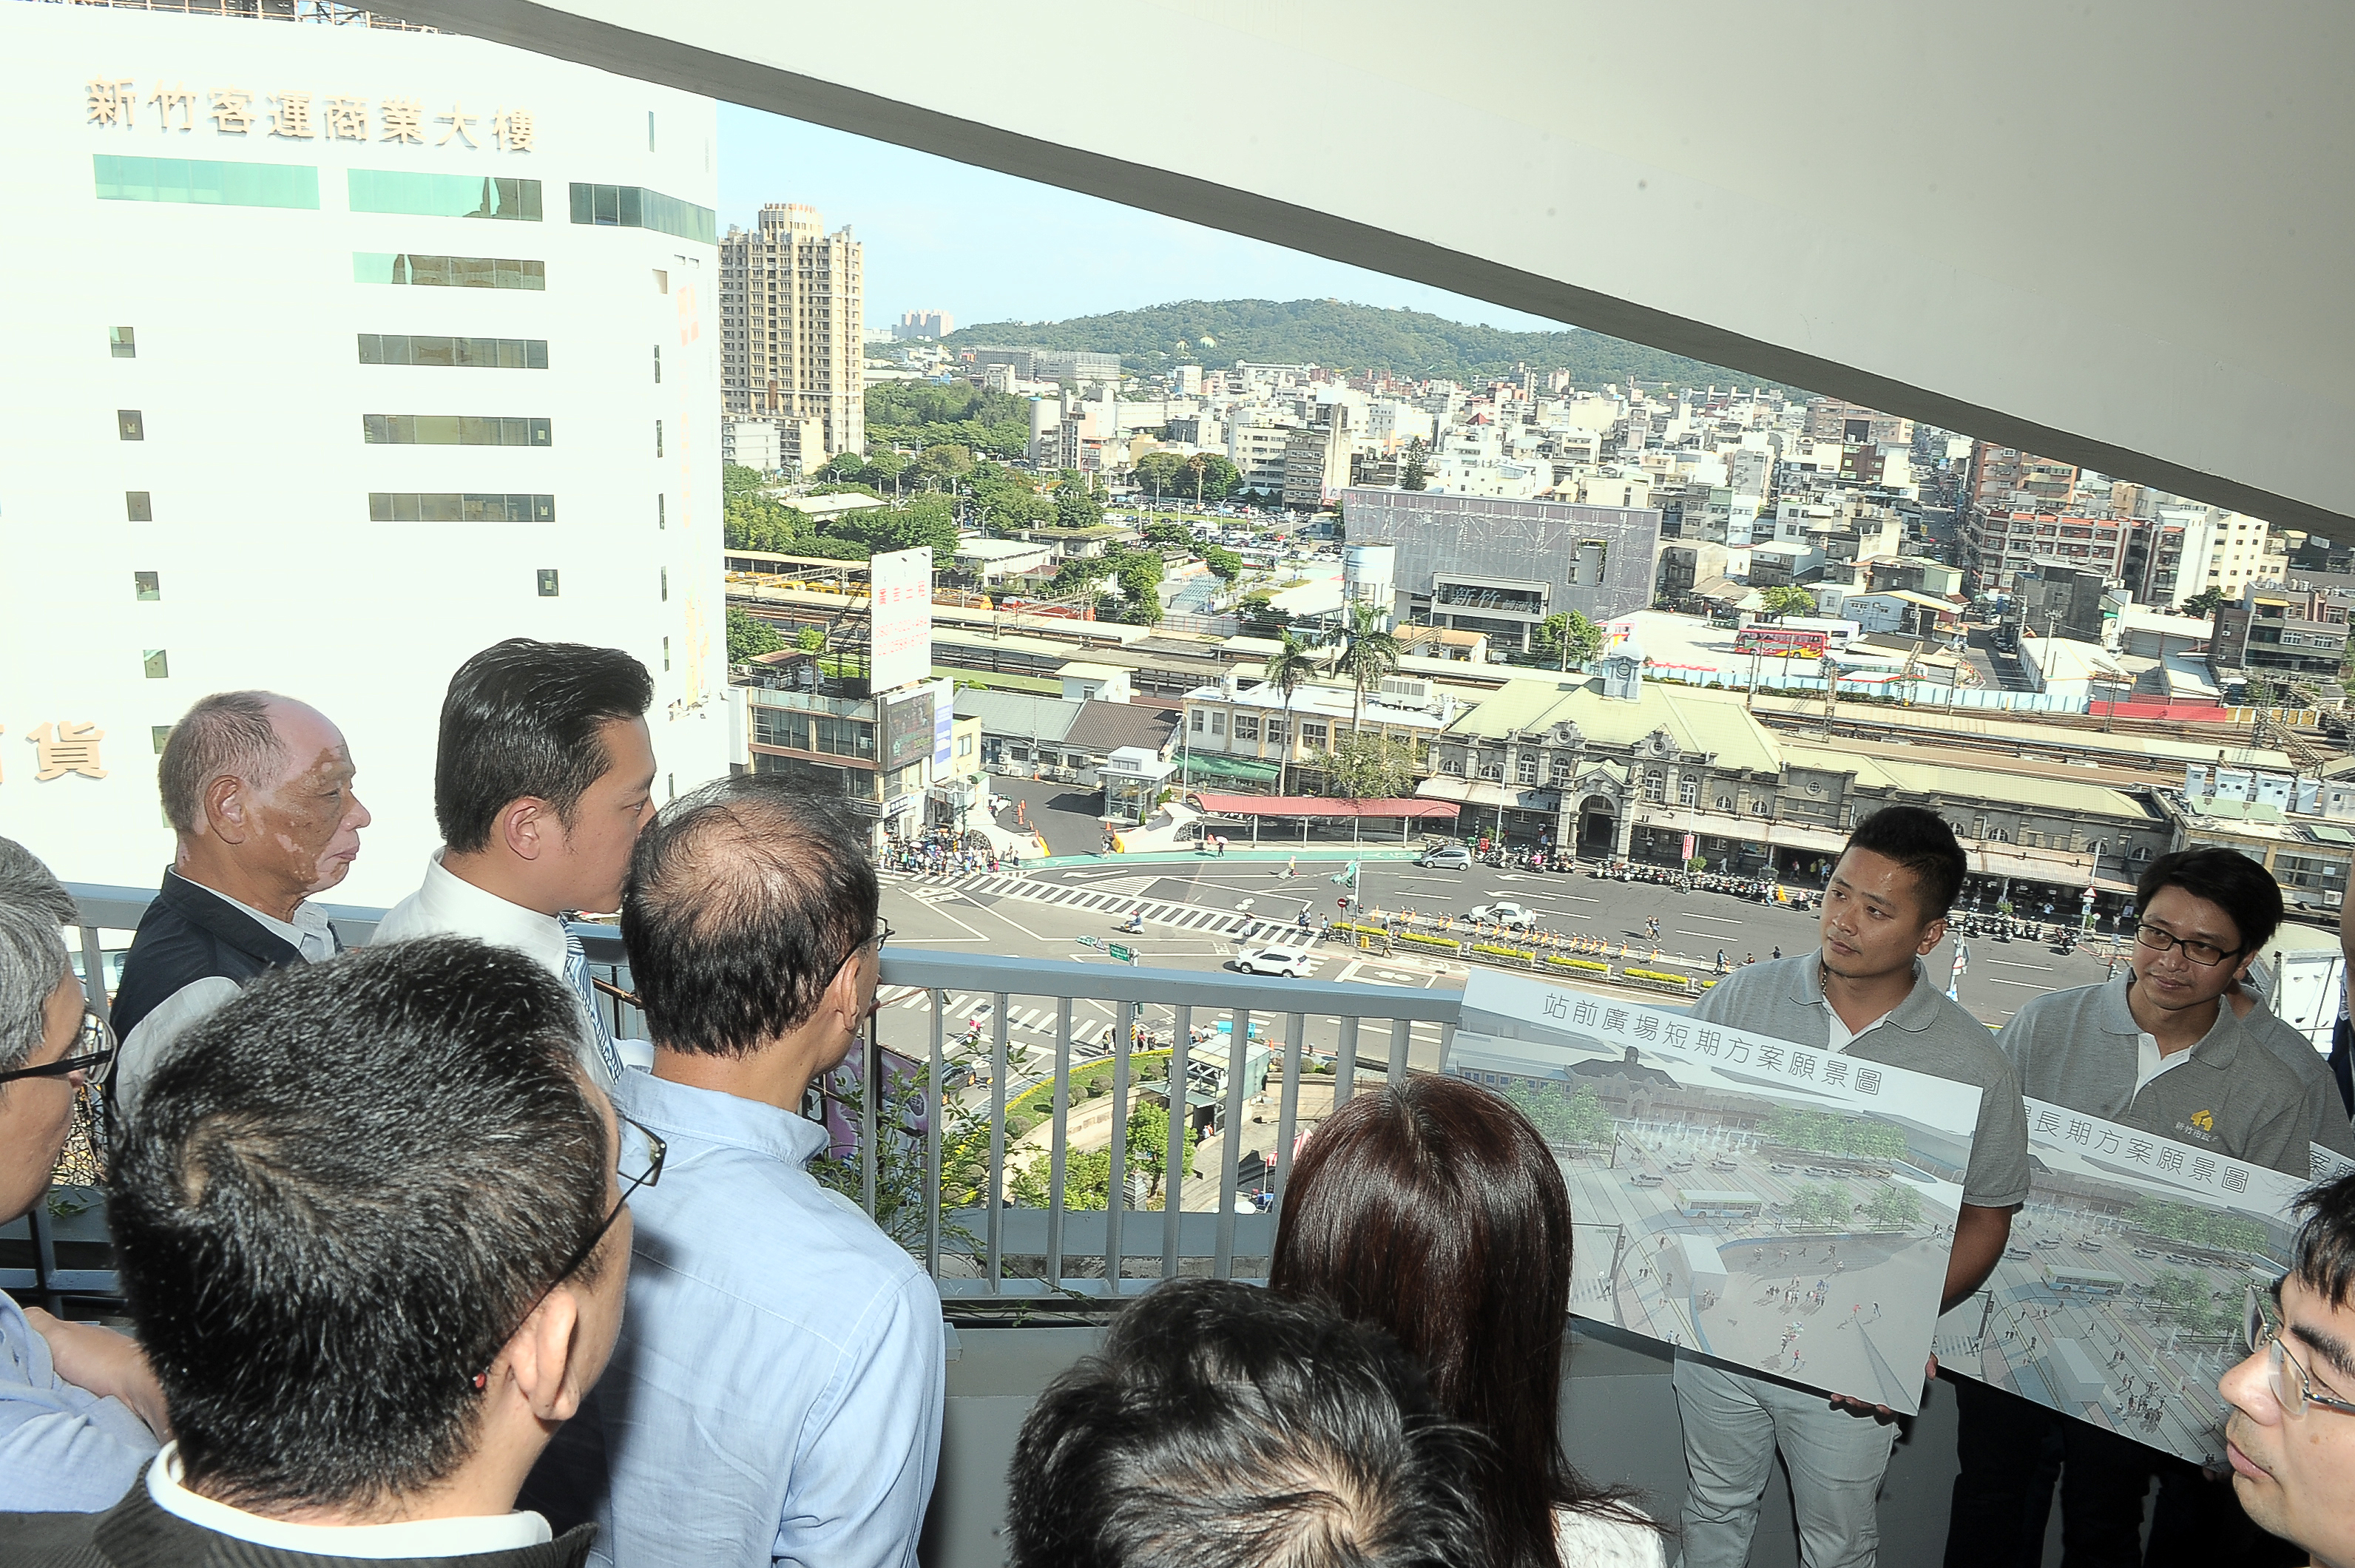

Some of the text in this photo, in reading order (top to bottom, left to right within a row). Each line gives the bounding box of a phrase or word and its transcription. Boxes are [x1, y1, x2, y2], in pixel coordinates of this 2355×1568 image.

[85, 75, 537, 154] 新竹客運商業大樓
[1542, 992, 1882, 1096] 站前廣場短期方案願景圖
[2024, 1105, 2250, 1194] 長期方案願景圖
